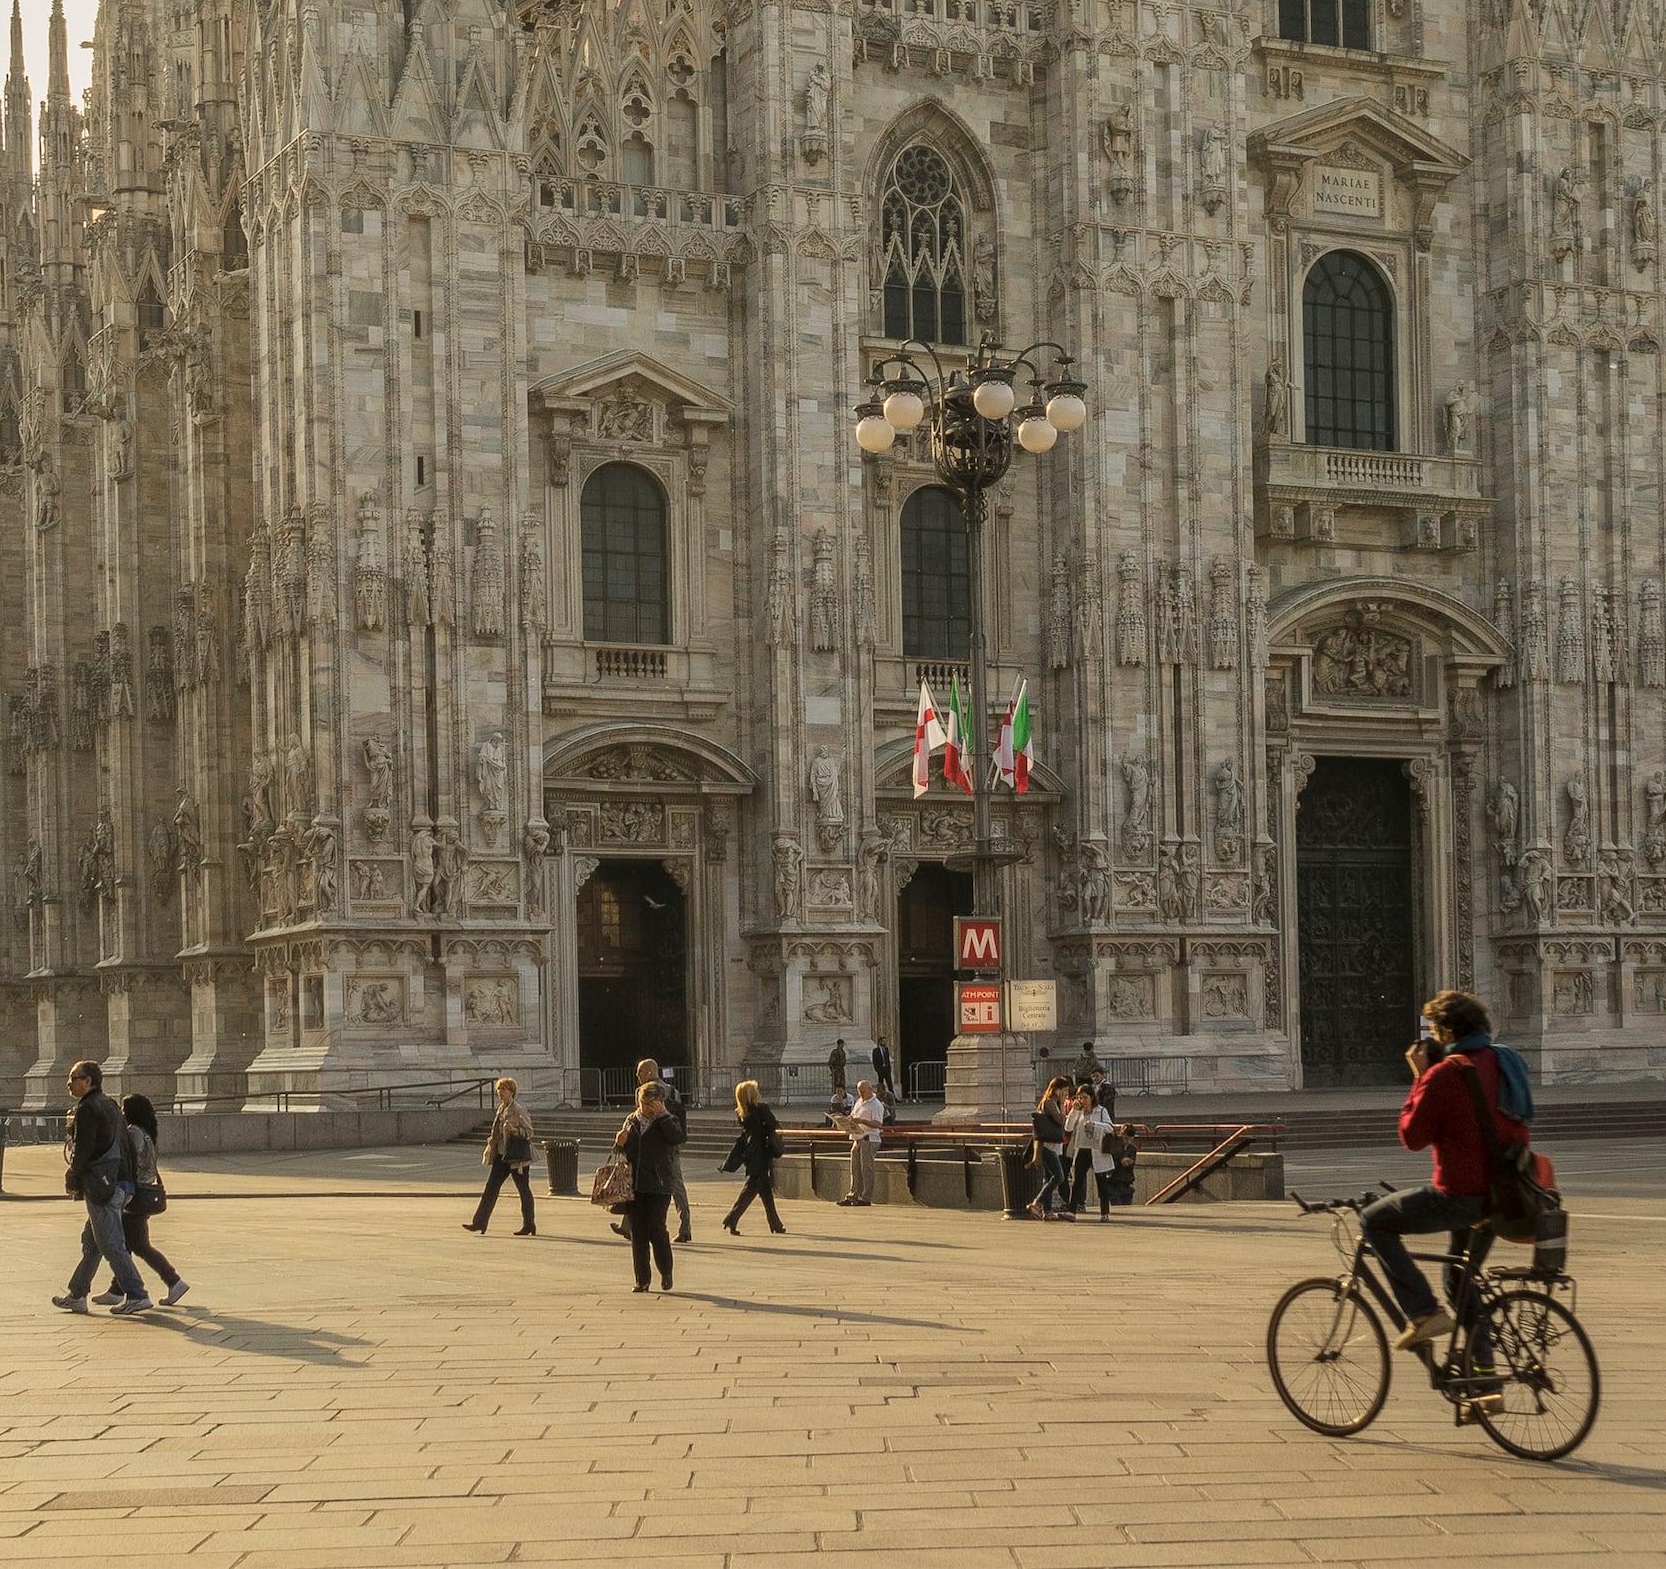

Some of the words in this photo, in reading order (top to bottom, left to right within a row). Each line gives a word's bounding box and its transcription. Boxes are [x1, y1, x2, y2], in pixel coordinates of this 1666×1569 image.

[1322, 174, 1370, 189] MARIAE
[1316, 191, 1376, 208] NASCENTI
[962, 929, 998, 958] M
